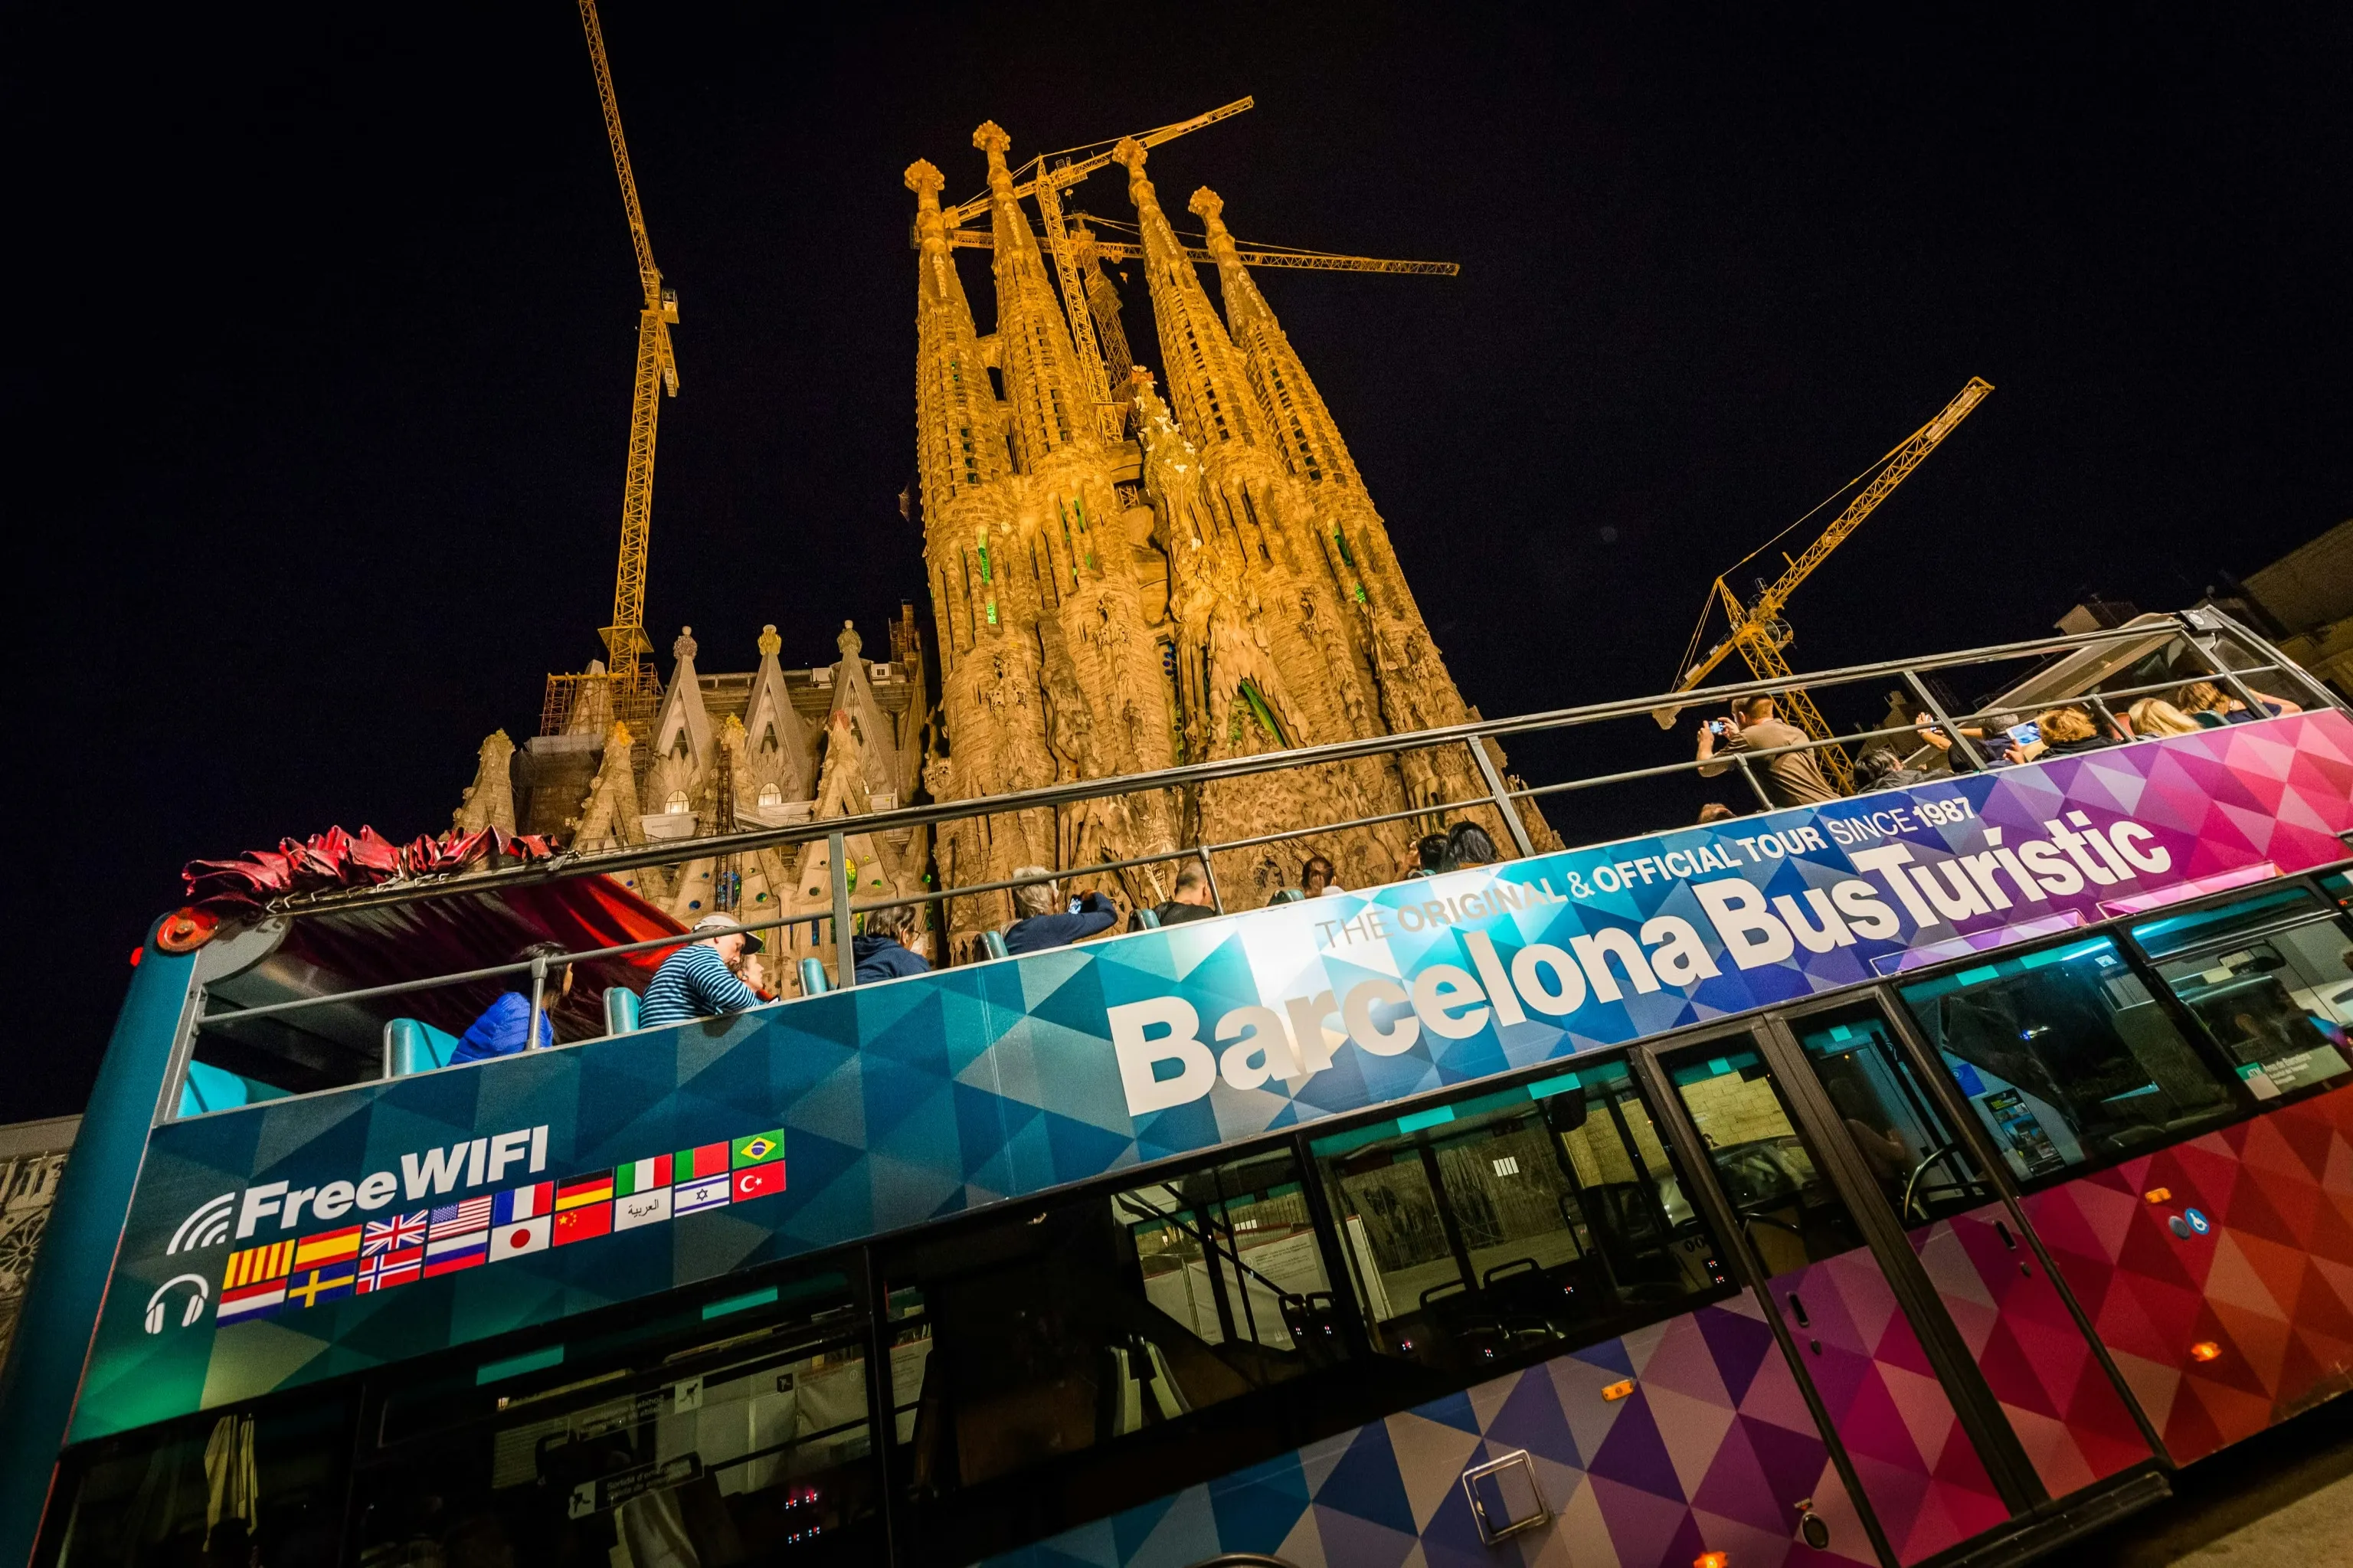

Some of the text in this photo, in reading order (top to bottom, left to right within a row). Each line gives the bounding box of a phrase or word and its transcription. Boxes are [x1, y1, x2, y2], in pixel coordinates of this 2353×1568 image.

[1314, 797, 1975, 948] THE ORIGINAL & OFFICIAL TOUR SINCE 1987
[1108, 915, 1723, 1117] Barcelona
[627, 1199, 659, 1218] العربية
